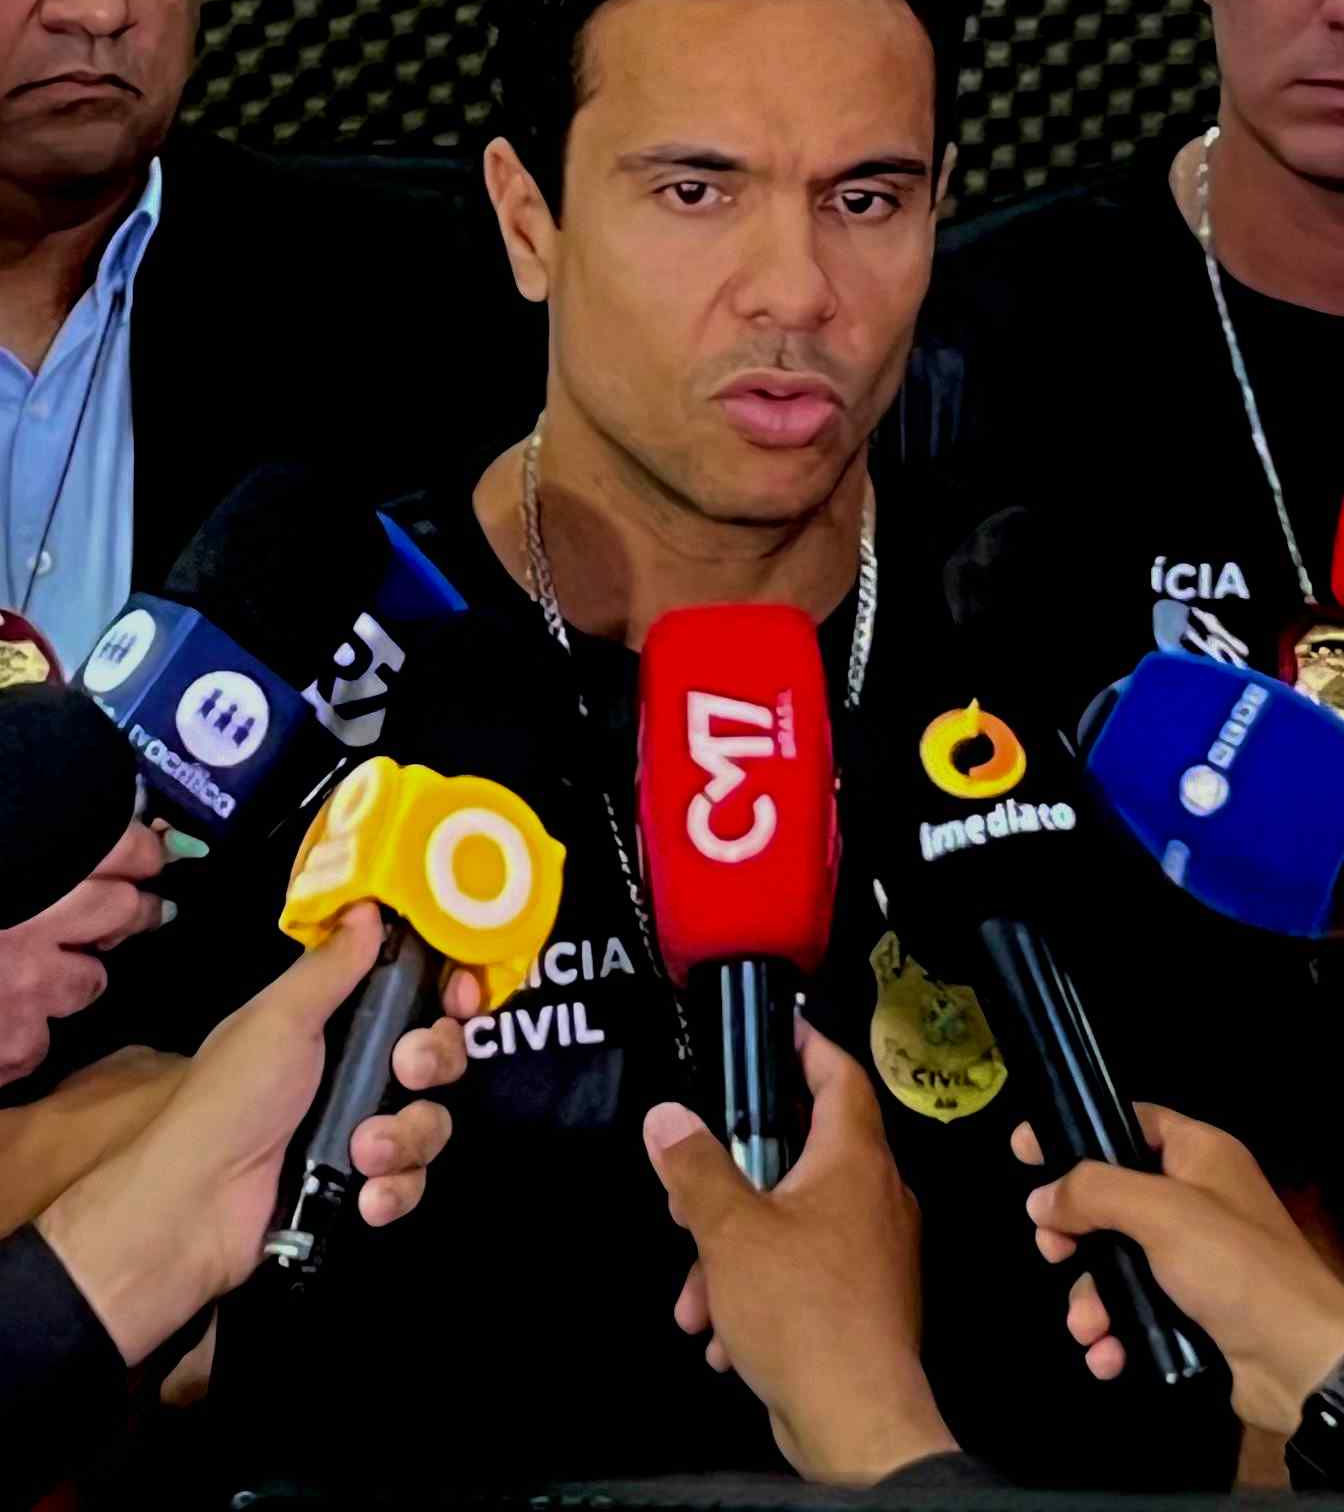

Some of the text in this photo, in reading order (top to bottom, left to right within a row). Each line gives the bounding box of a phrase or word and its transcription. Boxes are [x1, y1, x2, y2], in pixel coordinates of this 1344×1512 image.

[1150, 555, 1251, 601] ÍCIA
[686, 691, 777, 863] CM7
[463, 1001, 606, 1060] CIVIL
[912, 1066, 977, 1088] CIVIL
